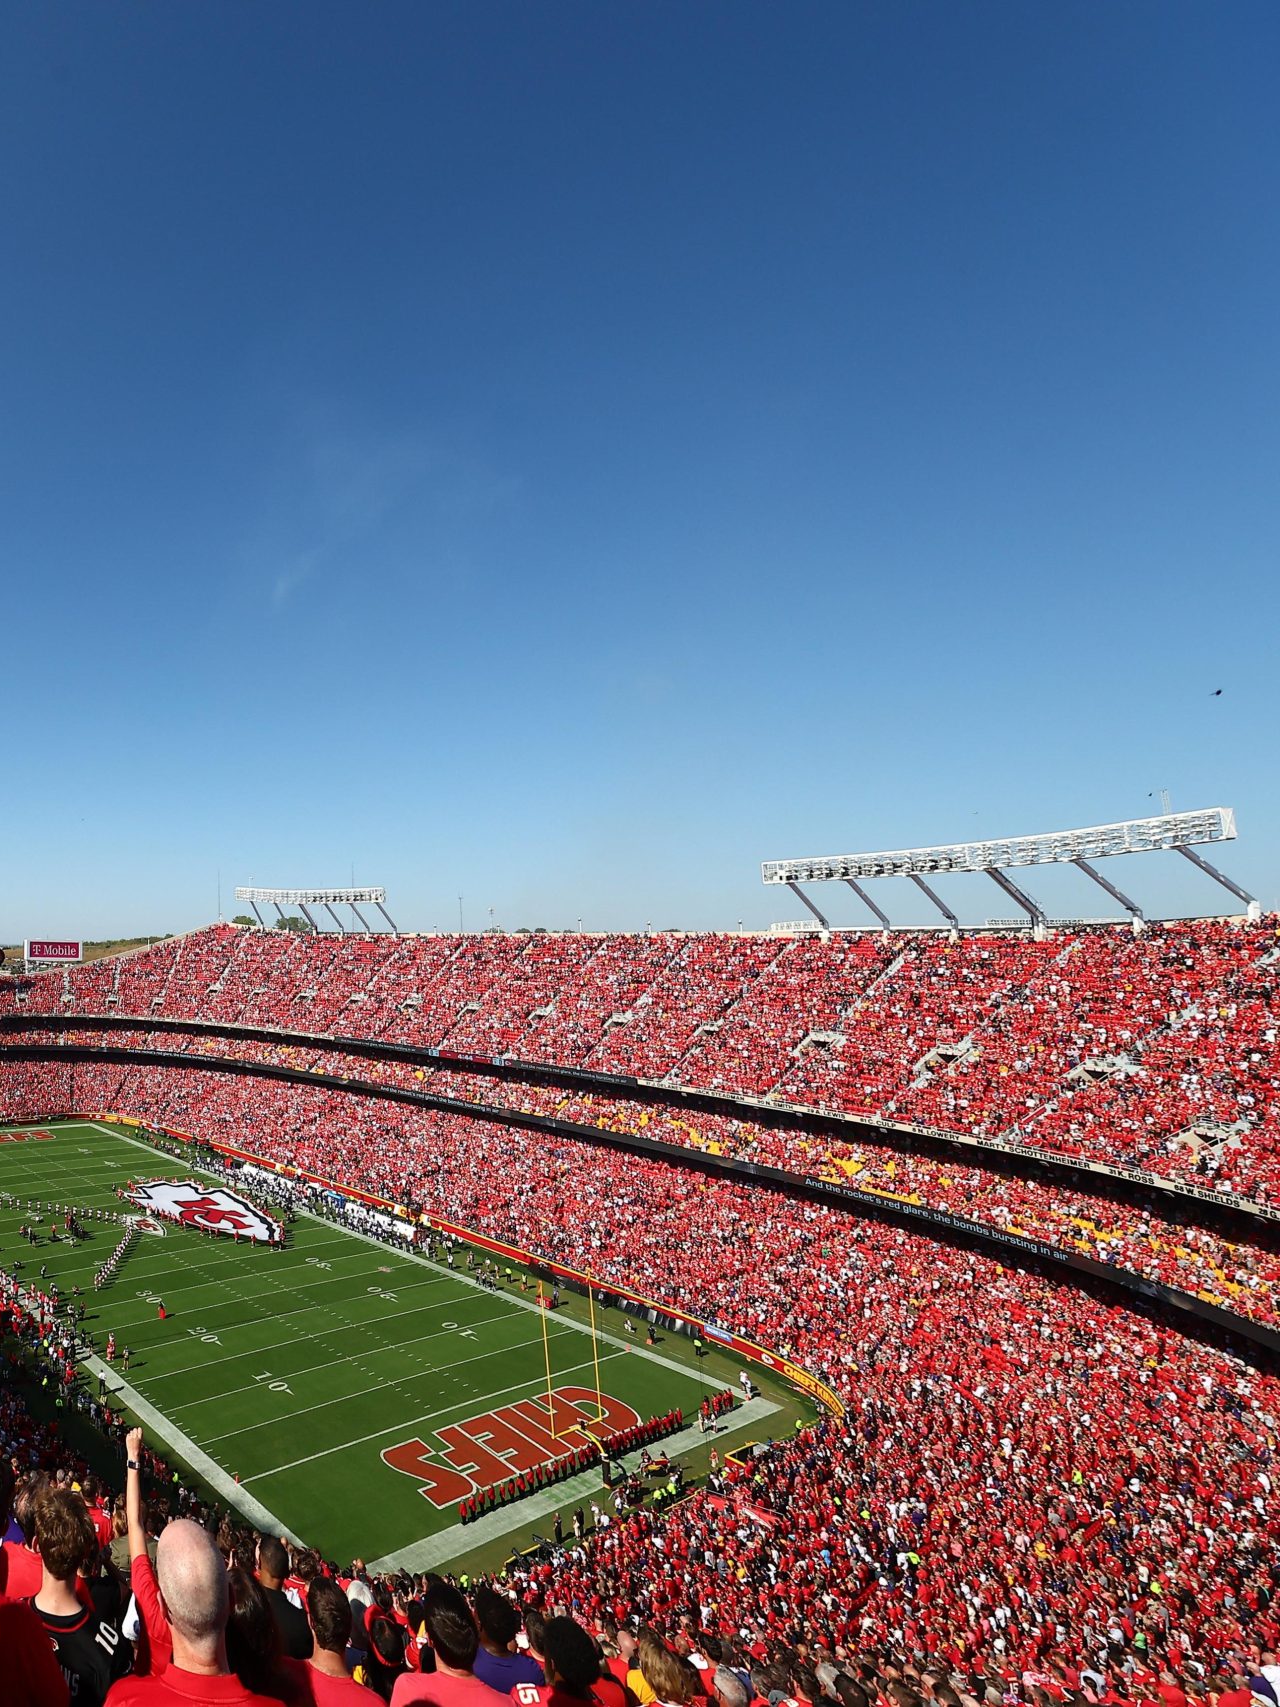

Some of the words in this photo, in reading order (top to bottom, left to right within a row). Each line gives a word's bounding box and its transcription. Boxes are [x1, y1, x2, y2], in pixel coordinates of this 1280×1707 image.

[773, 1102, 793, 1110] SMITH
[823, 1111, 846, 1119] LEWIS
[876, 1120, 896, 1128] CULP
[926, 1129, 960, 1141] LOWERY
[976, 1140, 1006, 1151] MARTY
[1008, 1146, 1091, 1169] SCHOTTENHEIMER
[1108, 1168, 1116, 1176] 31
[1128, 1172, 1155, 1185] ROSS
[1186, 1187, 1197, 1197] W.
[1198, 1191, 1240, 1208] SHIELDS
[805, 1178, 823, 1189] And
[826, 1184, 840, 1193] the
[843, 1189, 881, 1204] rocket's
[884, 1200, 900, 1209] red
[903, 1205, 931, 1219] glare,
[933, 1213, 950, 1224] the
[953, 1218, 989, 1236] bombs
[992, 1230, 1038, 1253] bursting
[1040, 1245, 1051, 1256] in
[1053, 1252, 1069, 1261] air
[136, 1290, 162, 1304] 30
[187, 1326, 218, 1343] 20
[441, 1322, 477, 1337] 10
[252, 1370, 288, 1392] 10
[380, 1386, 643, 1510] CHIEFS
[94, 1621, 119, 1656] 10
[516, 1683, 540, 1704] 15
